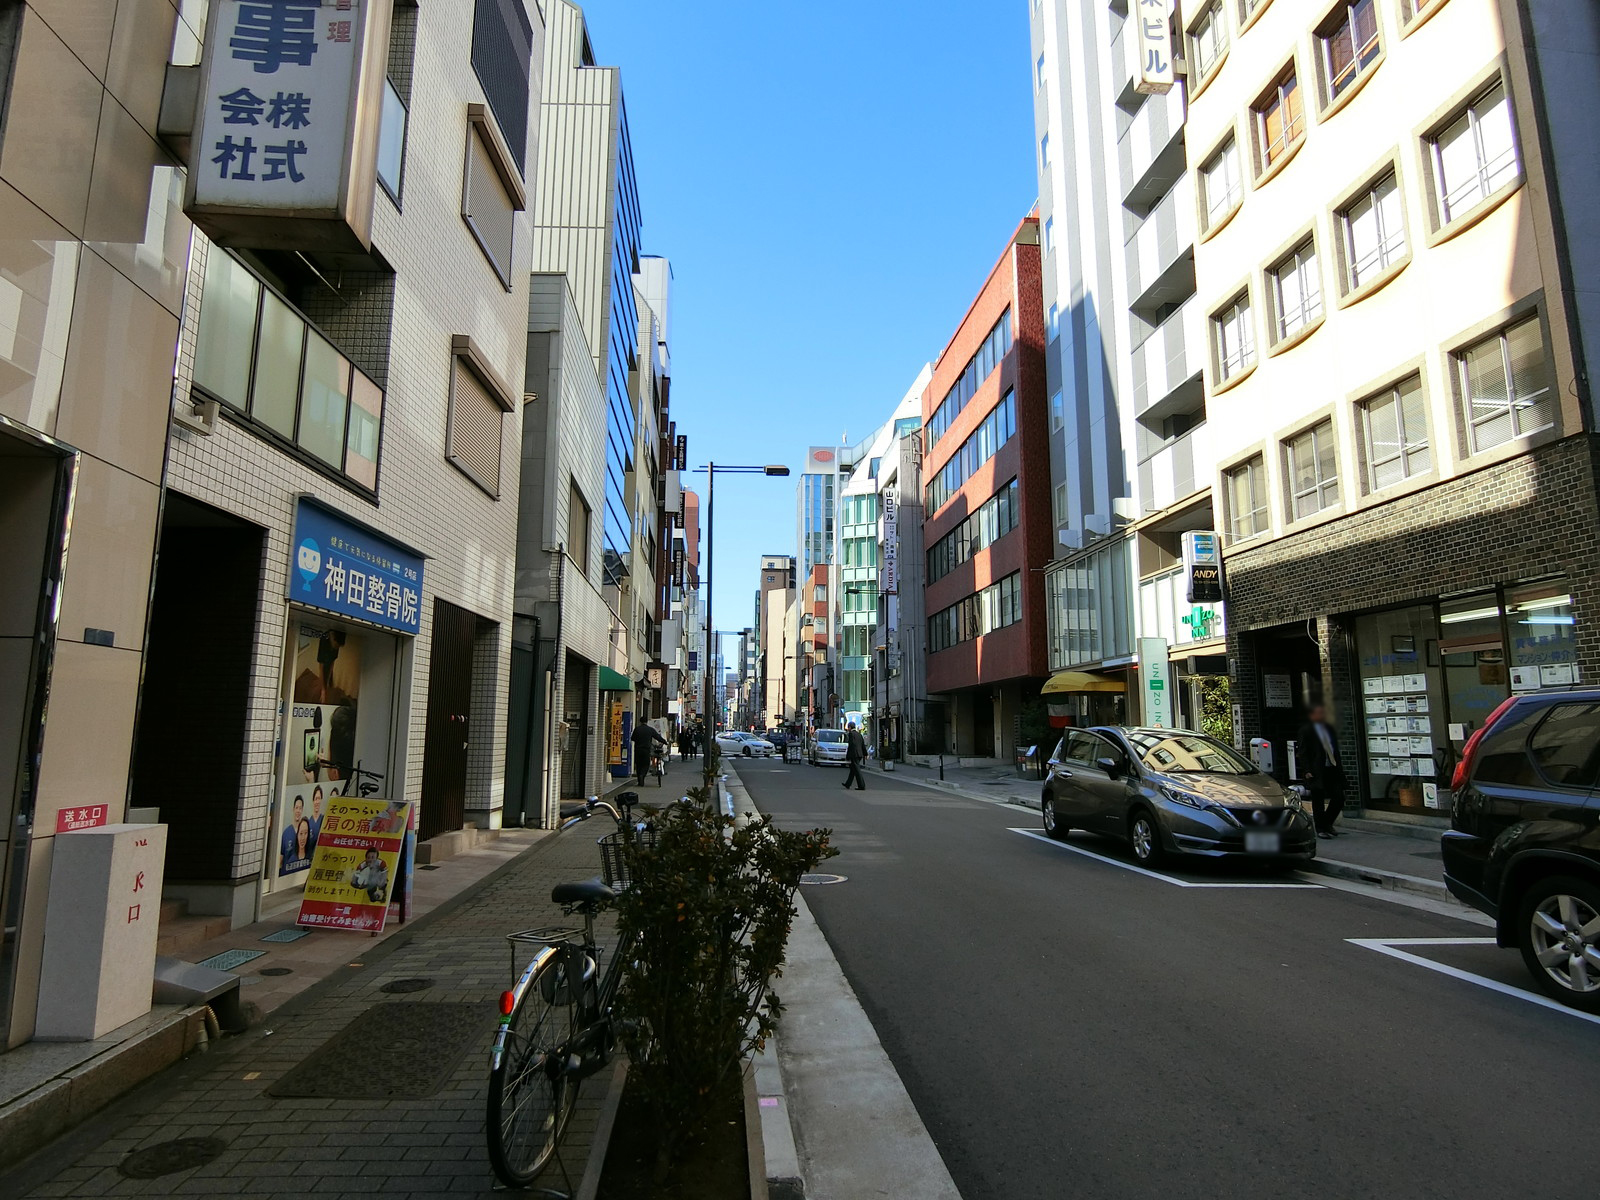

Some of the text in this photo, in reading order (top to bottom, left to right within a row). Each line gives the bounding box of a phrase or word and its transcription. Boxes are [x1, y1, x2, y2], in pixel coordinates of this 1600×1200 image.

[1140, 0, 1167, 73] ビル
[884, 490, 895, 521] 山口ビル
[1193, 570, 1218, 579] ANDY
[324, 557, 418, 626] 神田整骨院
[1152, 663, 1162, 706] UNIZO
[64, 807, 101, 823] 送水口
[329, 804, 380, 815] そのつらい
[323, 815, 386, 834] 肩の痛み
[321, 853, 356, 864] がっつり
[312, 868, 345, 882] 肩甲骨
[335, 906, 352, 915] 一度
